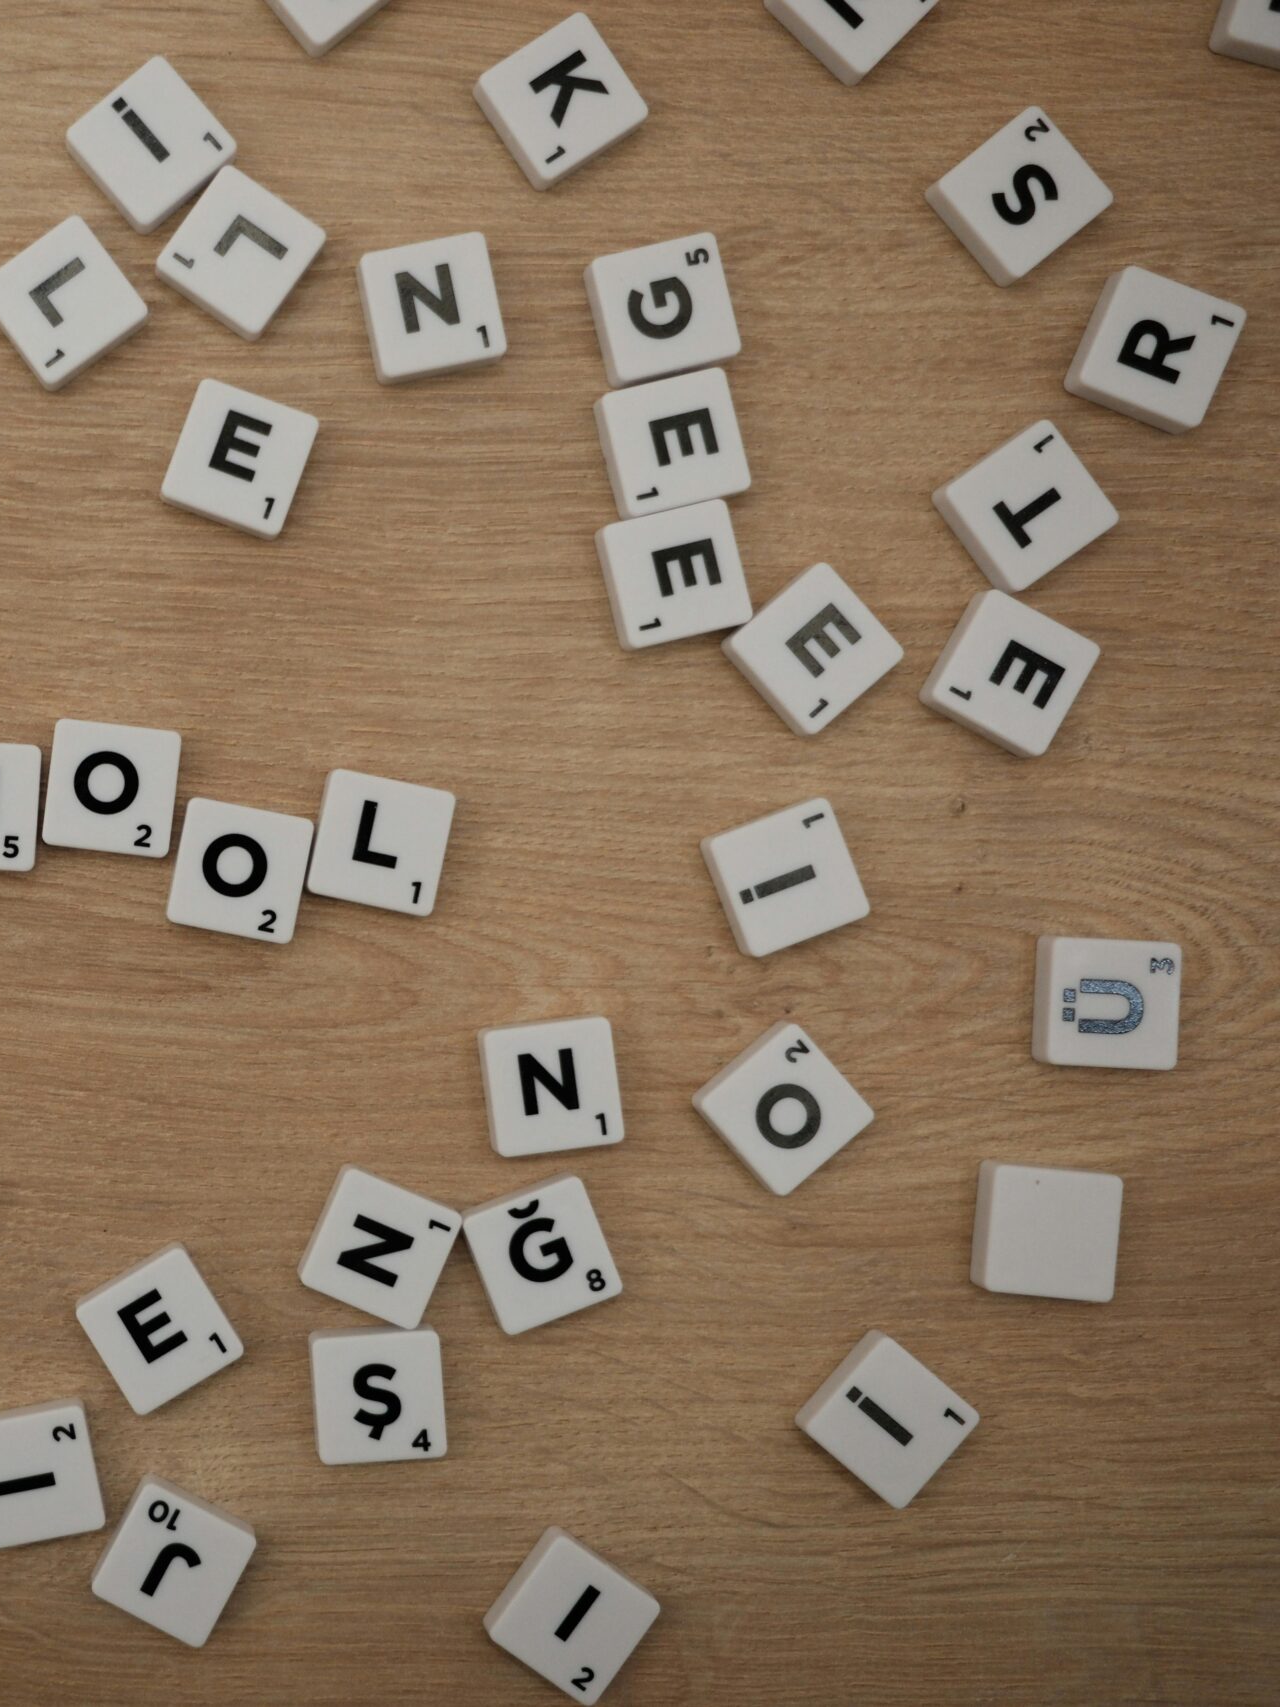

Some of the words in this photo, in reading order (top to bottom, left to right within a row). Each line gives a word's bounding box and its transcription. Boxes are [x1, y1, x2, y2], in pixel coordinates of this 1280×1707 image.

[528, 49, 610, 129] K
[202, 131, 223, 152] 1
[544, 145, 567, 165] 1
[1024, 117, 1051, 143] 2
[990, 163, 1059, 227] S
[172, 252, 195, 269] 1
[213, 213, 289, 261] L
[28, 256, 86, 328] L
[394, 262, 461, 335] N
[475, 324, 490, 349] 1
[626, 275, 694, 340] G
[684, 247, 710, 267] 5
[44, 348, 66, 369] 1
[1116, 318, 1197, 385] R
[1210, 313, 1236, 328] 1
[207, 408, 273, 483] E
[262, 496, 276, 521] 1
[647, 407, 720, 468] E
[635, 486, 660, 501] 1
[991, 486, 1063, 550] T
[1032, 433, 1055, 454] 1
[650, 537, 723, 598] E
[638, 617, 663, 632] 1
[784, 602, 863, 679] E
[948, 685, 973, 702] 1
[988, 639, 1067, 711] E
[808, 697, 830, 719] 1
[1, 834, 20, 859] 5
[133, 823, 153, 849] 2
[801, 812, 825, 829] 1
[257, 908, 278, 934] 2
[411, 880, 423, 905] 1
[1061, 977, 1145, 1036] Ü
[1149, 957, 1176, 976] 3
[784, 1038, 811, 1064] 2
[516, 1047, 581, 1117] N
[594, 1112, 608, 1136] 1
[754, 1082, 822, 1150] O
[335, 1213, 416, 1289] N
[427, 1218, 452, 1233] 1
[506, 1198, 575, 1284] Ğ
[585, 1267, 607, 1293] 8
[116, 1287, 189, 1365] E
[208, 1331, 228, 1355] 1
[51, 1422, 77, 1443] 2
[352, 1362, 403, 1442] Ş
[410, 1428, 432, 1453] 4
[943, 1407, 966, 1426] 1
[139, 1541, 203, 1598] J
[570, 1666, 595, 1692] 2
